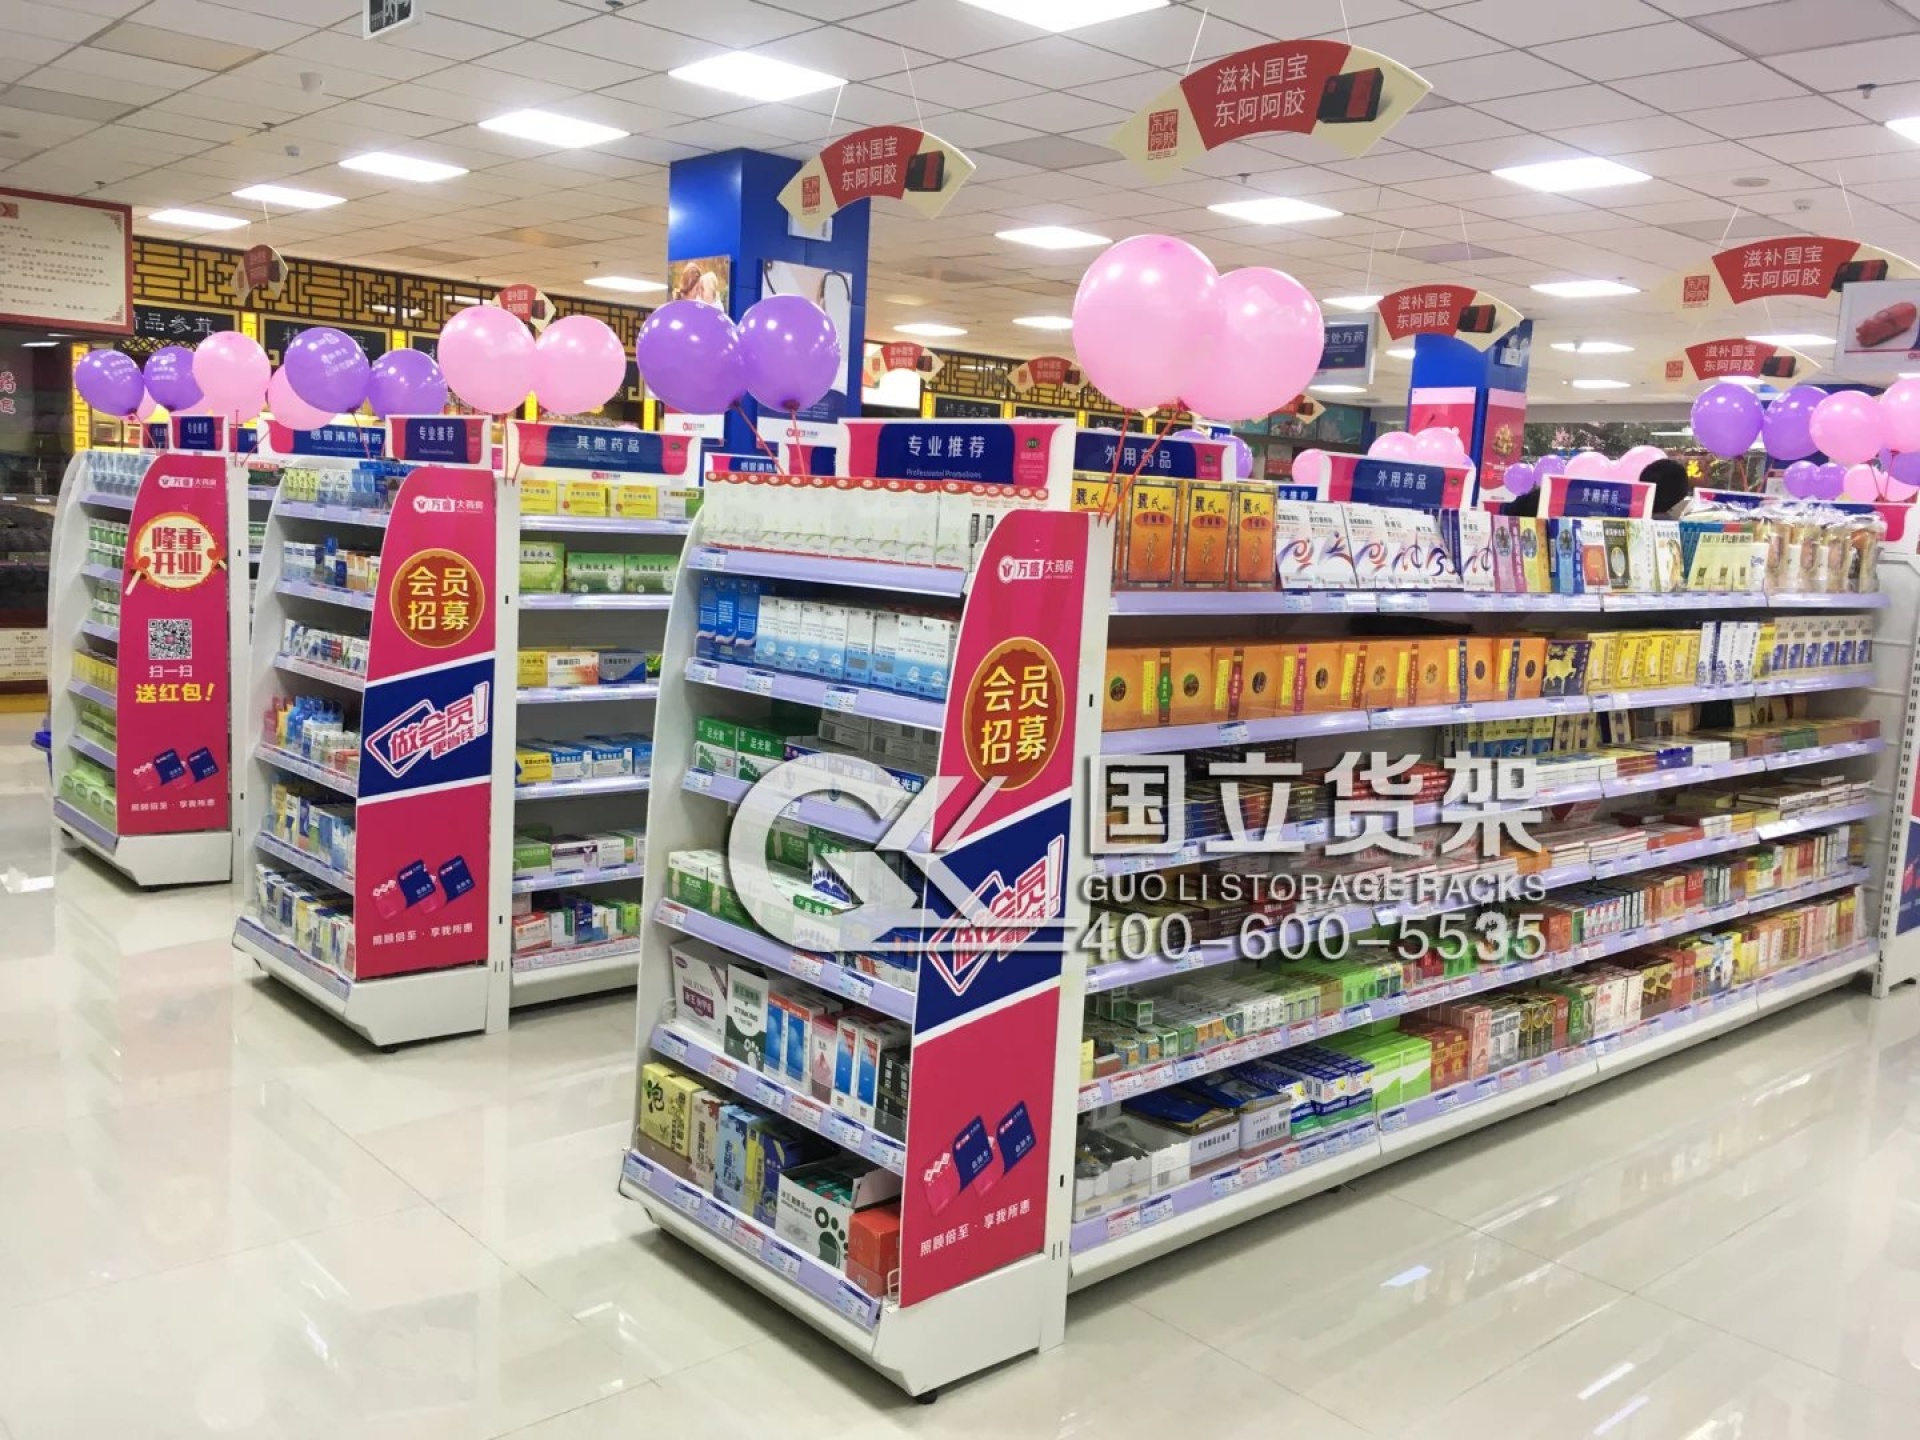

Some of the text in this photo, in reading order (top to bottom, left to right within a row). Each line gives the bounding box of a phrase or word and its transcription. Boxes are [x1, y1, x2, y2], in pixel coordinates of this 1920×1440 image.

[1217, 52, 1309, 95] 滋补国宝
[1214, 88, 1306, 128] 东阿阿胶
[841, 136, 898, 166] 滋补国宝
[841, 163, 897, 192] 东阿阿胶
[1743, 245, 1824, 269] 滋补国宝
[1741, 268, 1822, 290] 东阿阿胶
[1398, 292, 1452, 311] 滋补国宝
[1397, 311, 1451, 329] 东阿阿胶
[1704, 359, 1755, 372] 东阿阿胶
[418, 424, 454, 443] 专业推荐
[576, 435, 640, 454] 其他药品
[907, 434, 986, 459] 专业推荐
[1104, 445, 1172, 470] 外用药品
[1375, 469, 1428, 490] 外用药品
[151, 527, 202, 550] 隆重
[151, 551, 203, 576] 开业
[1015, 559, 1074, 580] 万盛大药房
[407, 566, 470, 597] 会员
[407, 600, 470, 631] 招募
[148, 665, 193, 679] 扫一扫
[135, 683, 216, 704] 送红包!
[983, 665, 1049, 712] 会员
[981, 714, 1048, 767] 招募
